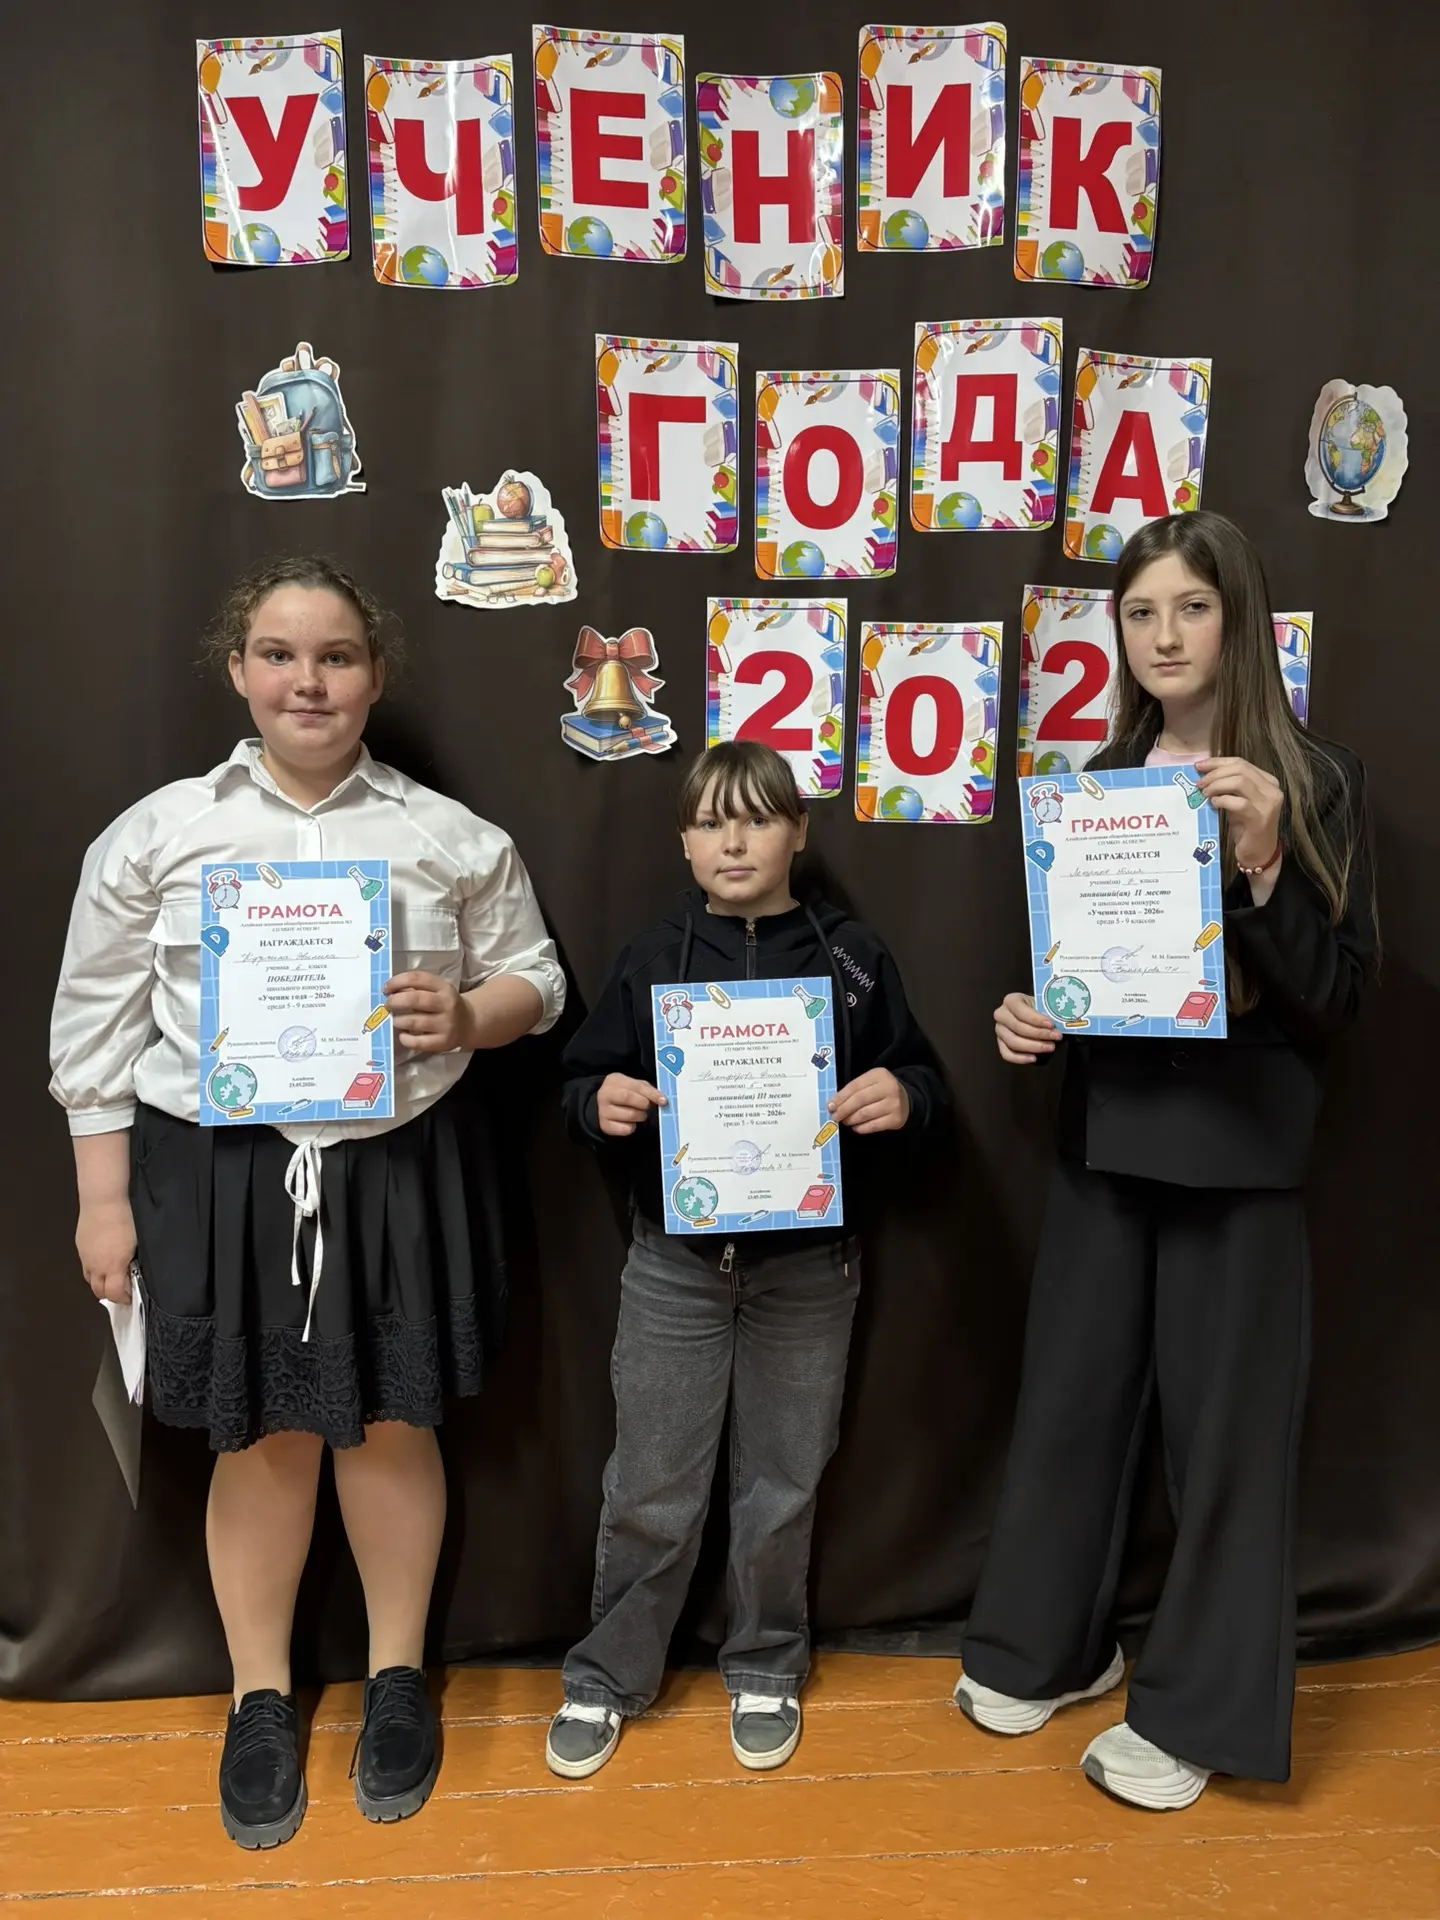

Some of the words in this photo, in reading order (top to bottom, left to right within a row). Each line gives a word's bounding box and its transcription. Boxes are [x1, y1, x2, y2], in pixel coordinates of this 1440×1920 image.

[226, 85, 1131, 243] УЧЕНИК
[630, 375, 1168, 529] ГОДА
[734, 641, 1110, 775] 202
[1071, 814, 1169, 833] ГРАМОТА
[1086, 851, 1160, 861] НАГРАЖДАЕТСЯ
[247, 904, 343, 919] ГРАМОТА
[260, 938, 333, 947] НАГРАЖДАЕТСЯ
[267, 974, 326, 983] ПОБЕДИТЕЛЬ
[700, 1023, 789, 1039] ГРАМОТА
[713, 1057, 782, 1066] НАГРАЖДАЕТСЯ
